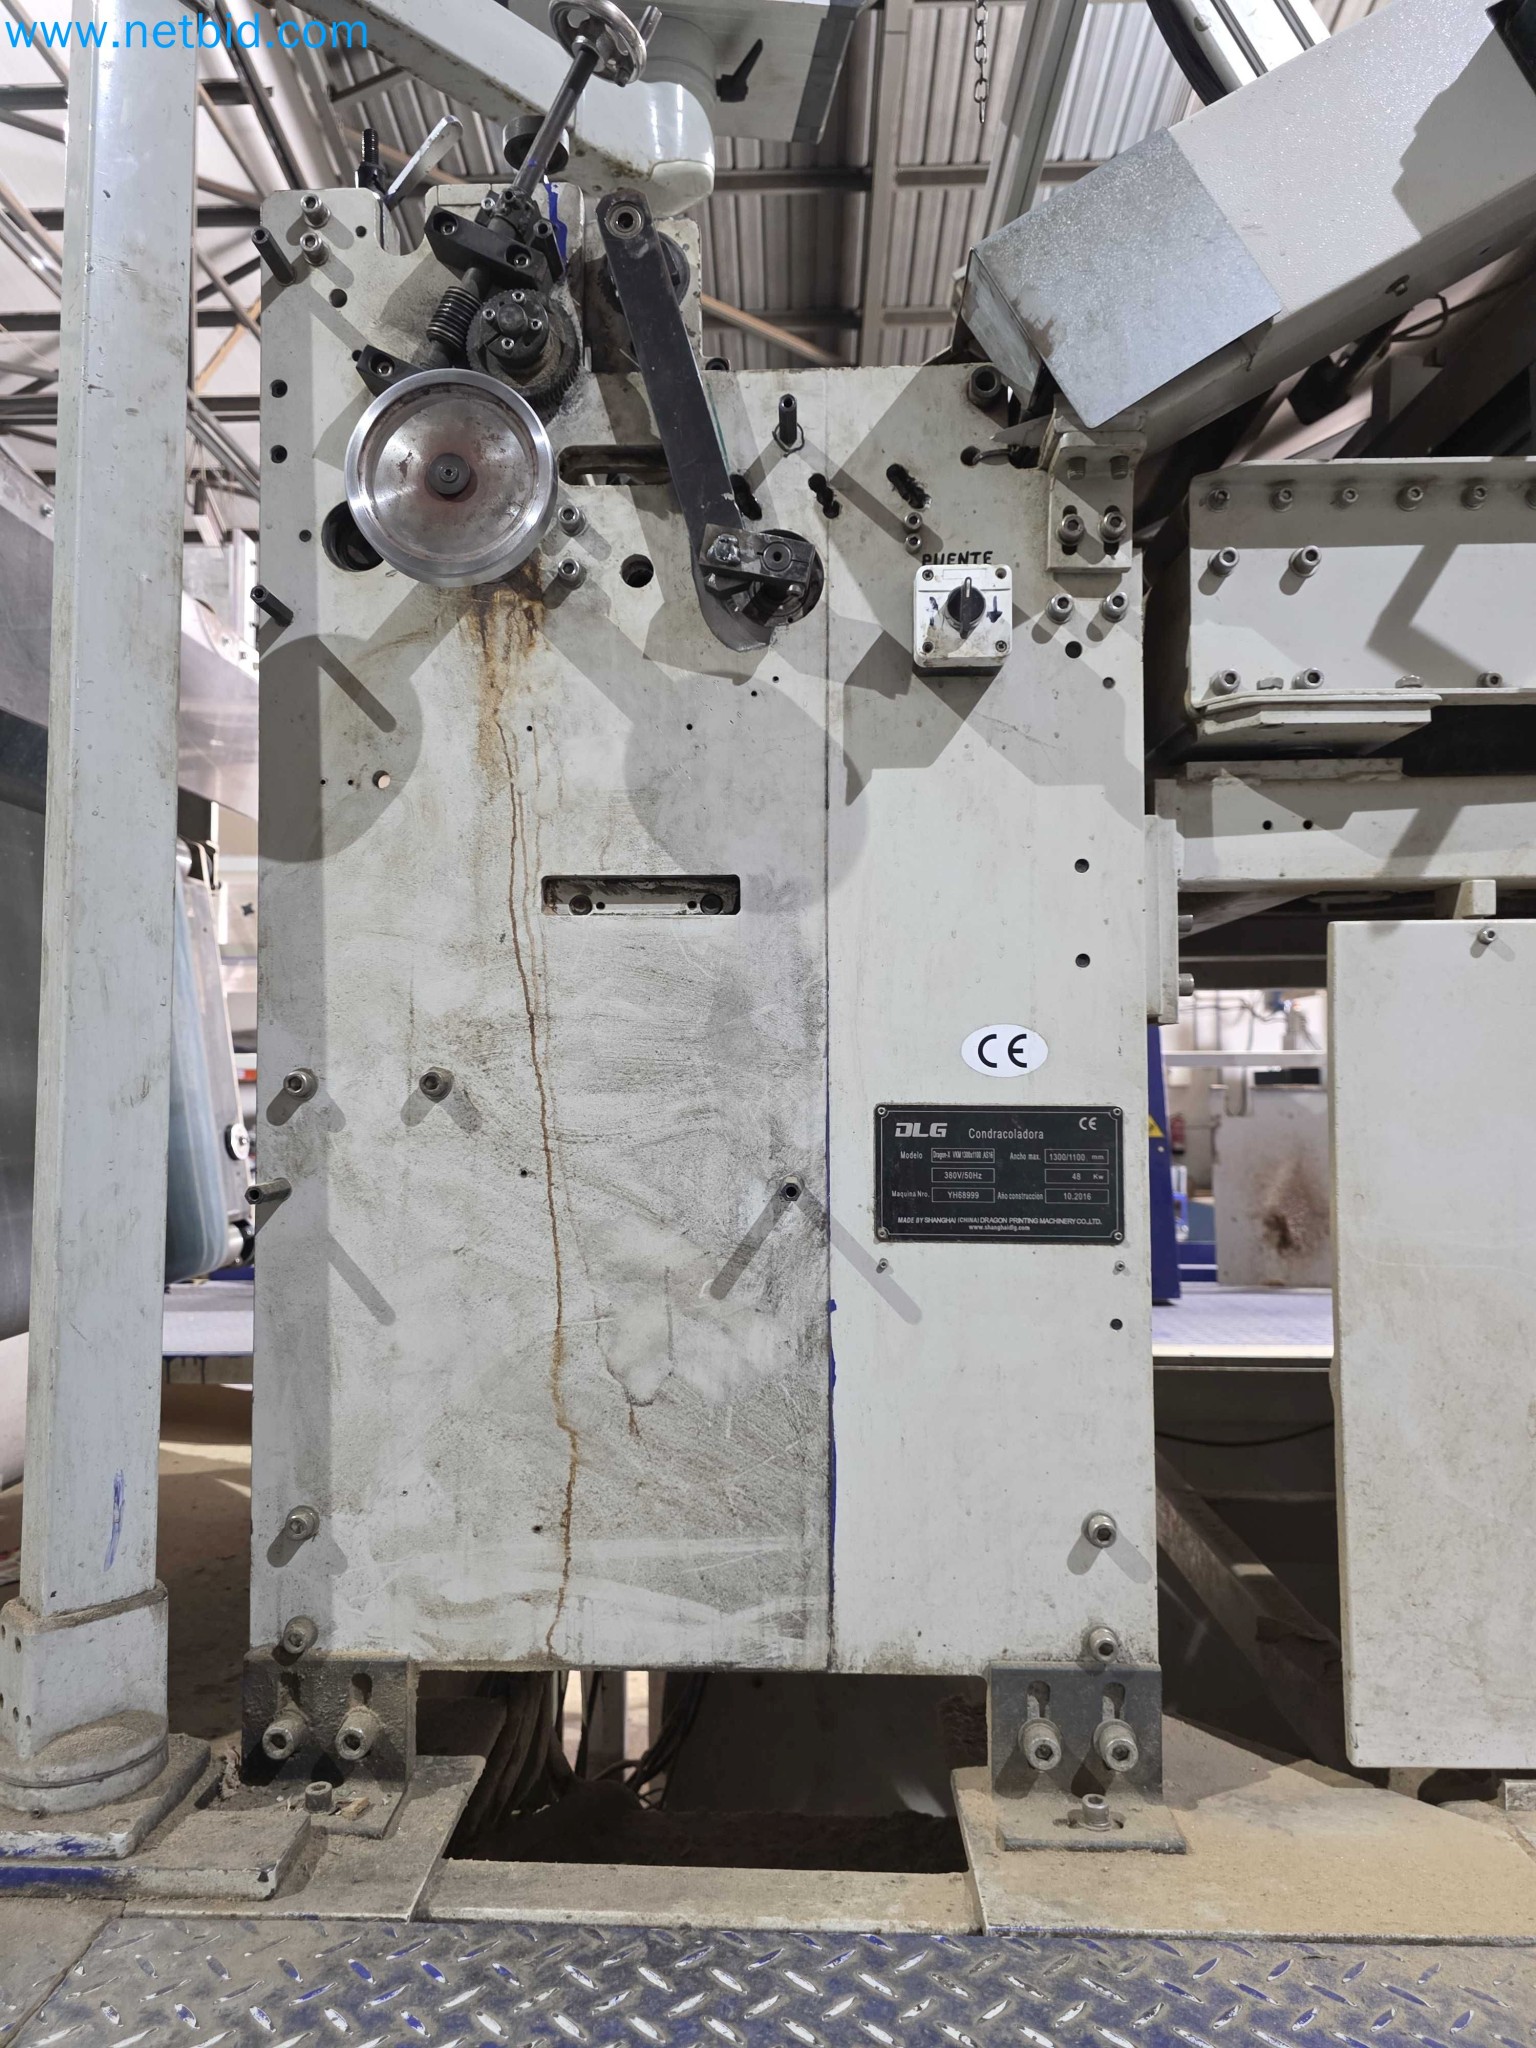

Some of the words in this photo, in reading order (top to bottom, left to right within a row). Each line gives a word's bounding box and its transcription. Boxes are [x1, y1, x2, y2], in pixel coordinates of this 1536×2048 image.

[921, 551, 993, 566] PUENTE
[978, 1034, 1027, 1068] CE
[1079, 1117, 1097, 1131] CE
[895, 1122, 948, 1138] DLG
[968, 1127, 1044, 1140] Condracoladora
[900, 1151, 923, 1160] Modelo
[1010, 1152, 1027, 1161] Ancho
[1049, 1153, 1086, 1162] 1300/1100
[944, 1171, 983, 1180] 380V/50Hz
[1072, 1172, 1082, 1181] 48
[891, 1190, 917, 1199] Maquina
[918, 1190, 931, 1199] Nro.
[947, 1191, 980, 1200] YH68999
[1063, 1192, 1092, 1201] 10.2016
[897, 1216, 915, 1224] MADE
[915, 1216, 924, 1224] BY
[924, 1216, 957, 1224] SHANGHAI
[980, 1216, 1008, 1225] DRAGON
[1009, 1217, 1039, 1225] PRINTING
[1039, 1217, 1077, 1225] MACHINERY
